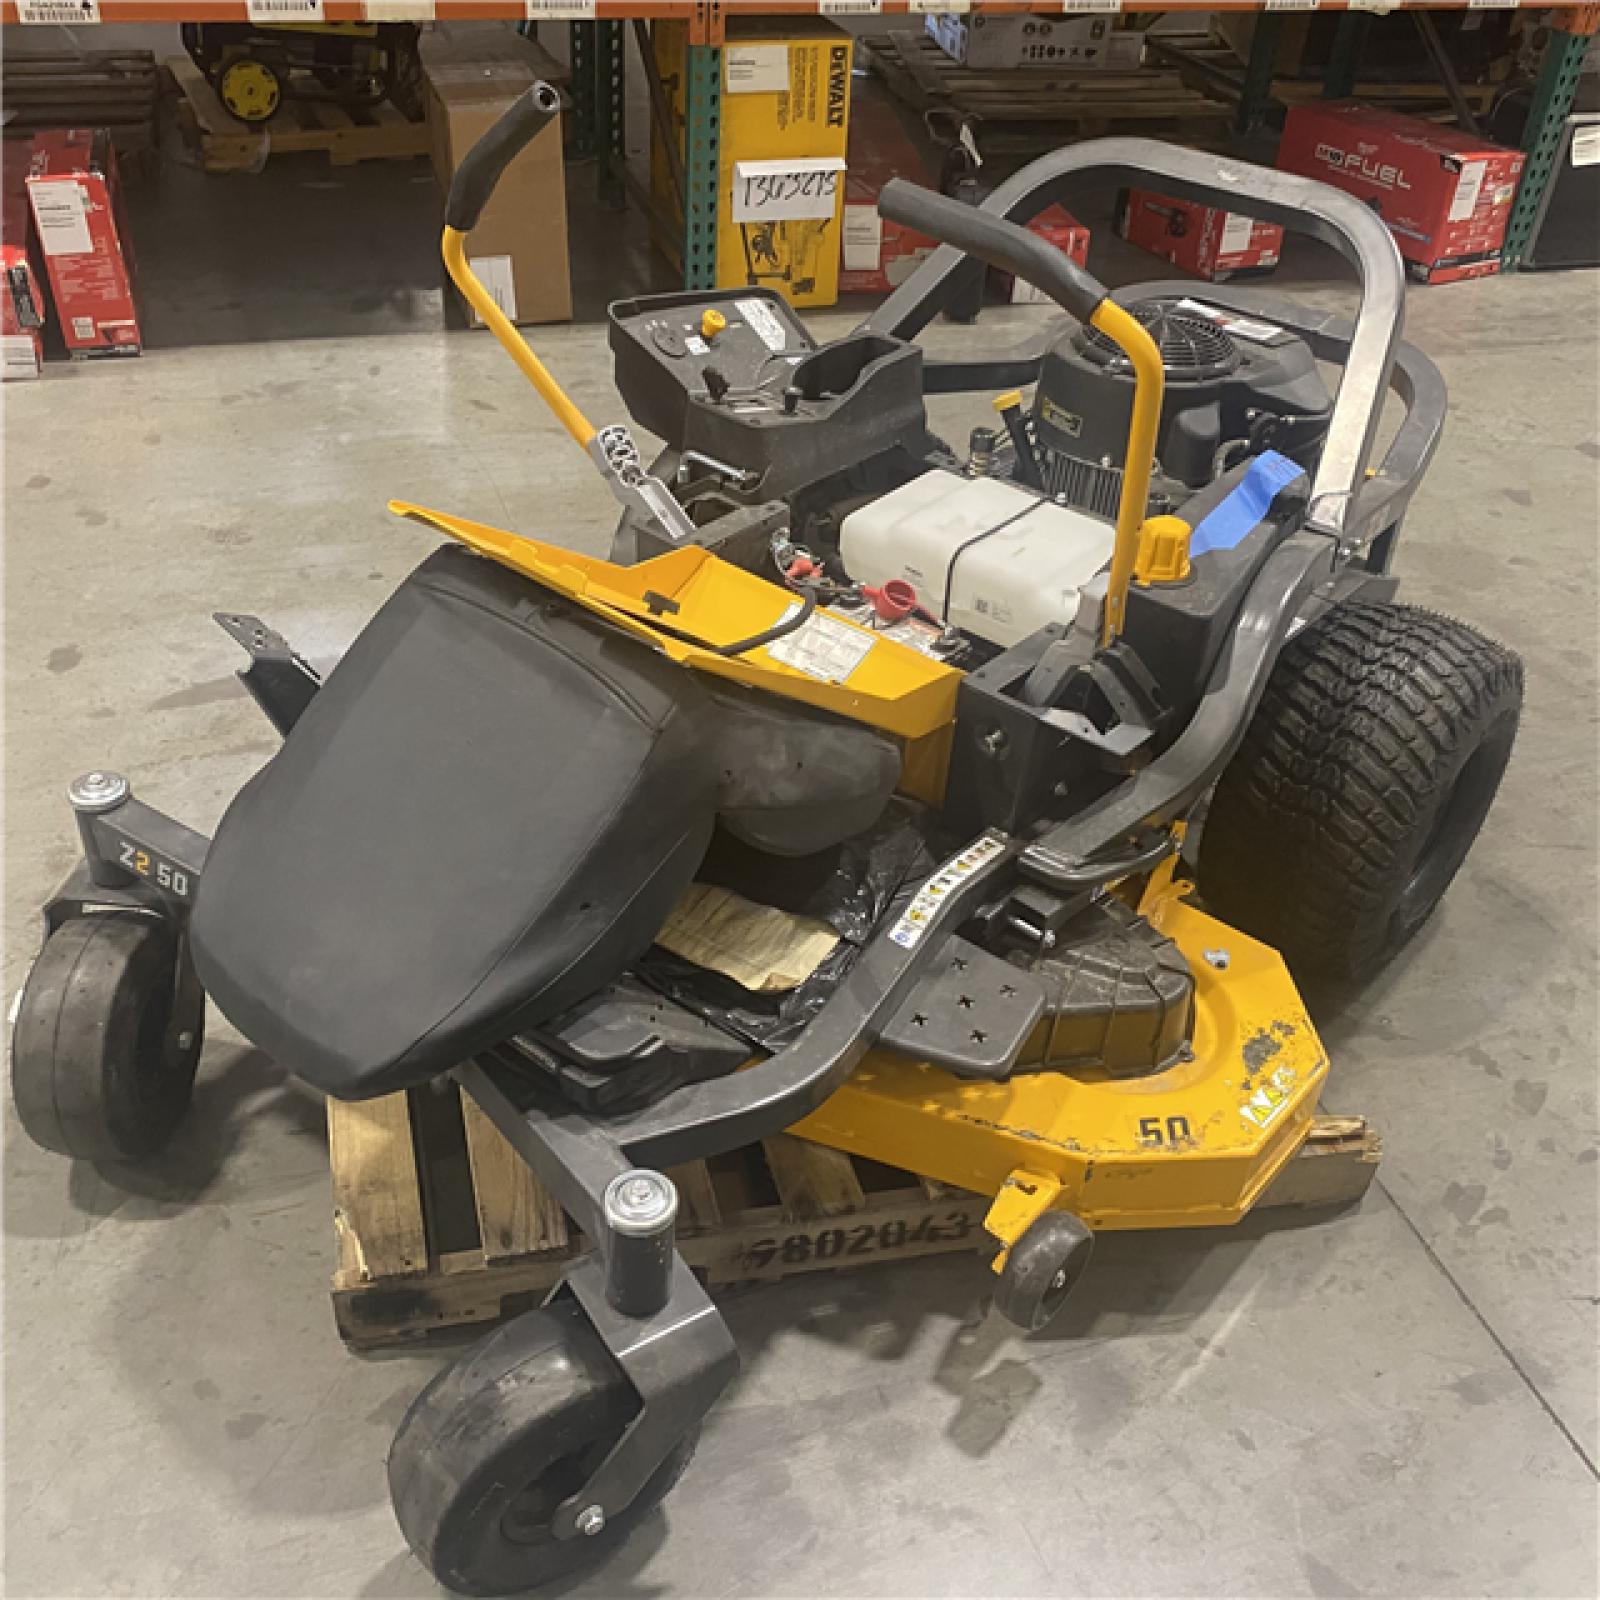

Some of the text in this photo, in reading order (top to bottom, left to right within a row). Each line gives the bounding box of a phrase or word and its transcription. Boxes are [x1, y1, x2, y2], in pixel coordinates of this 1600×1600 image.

[827, 45, 848, 128] DEWALT
[119, 841, 189, 896] Z2 50
